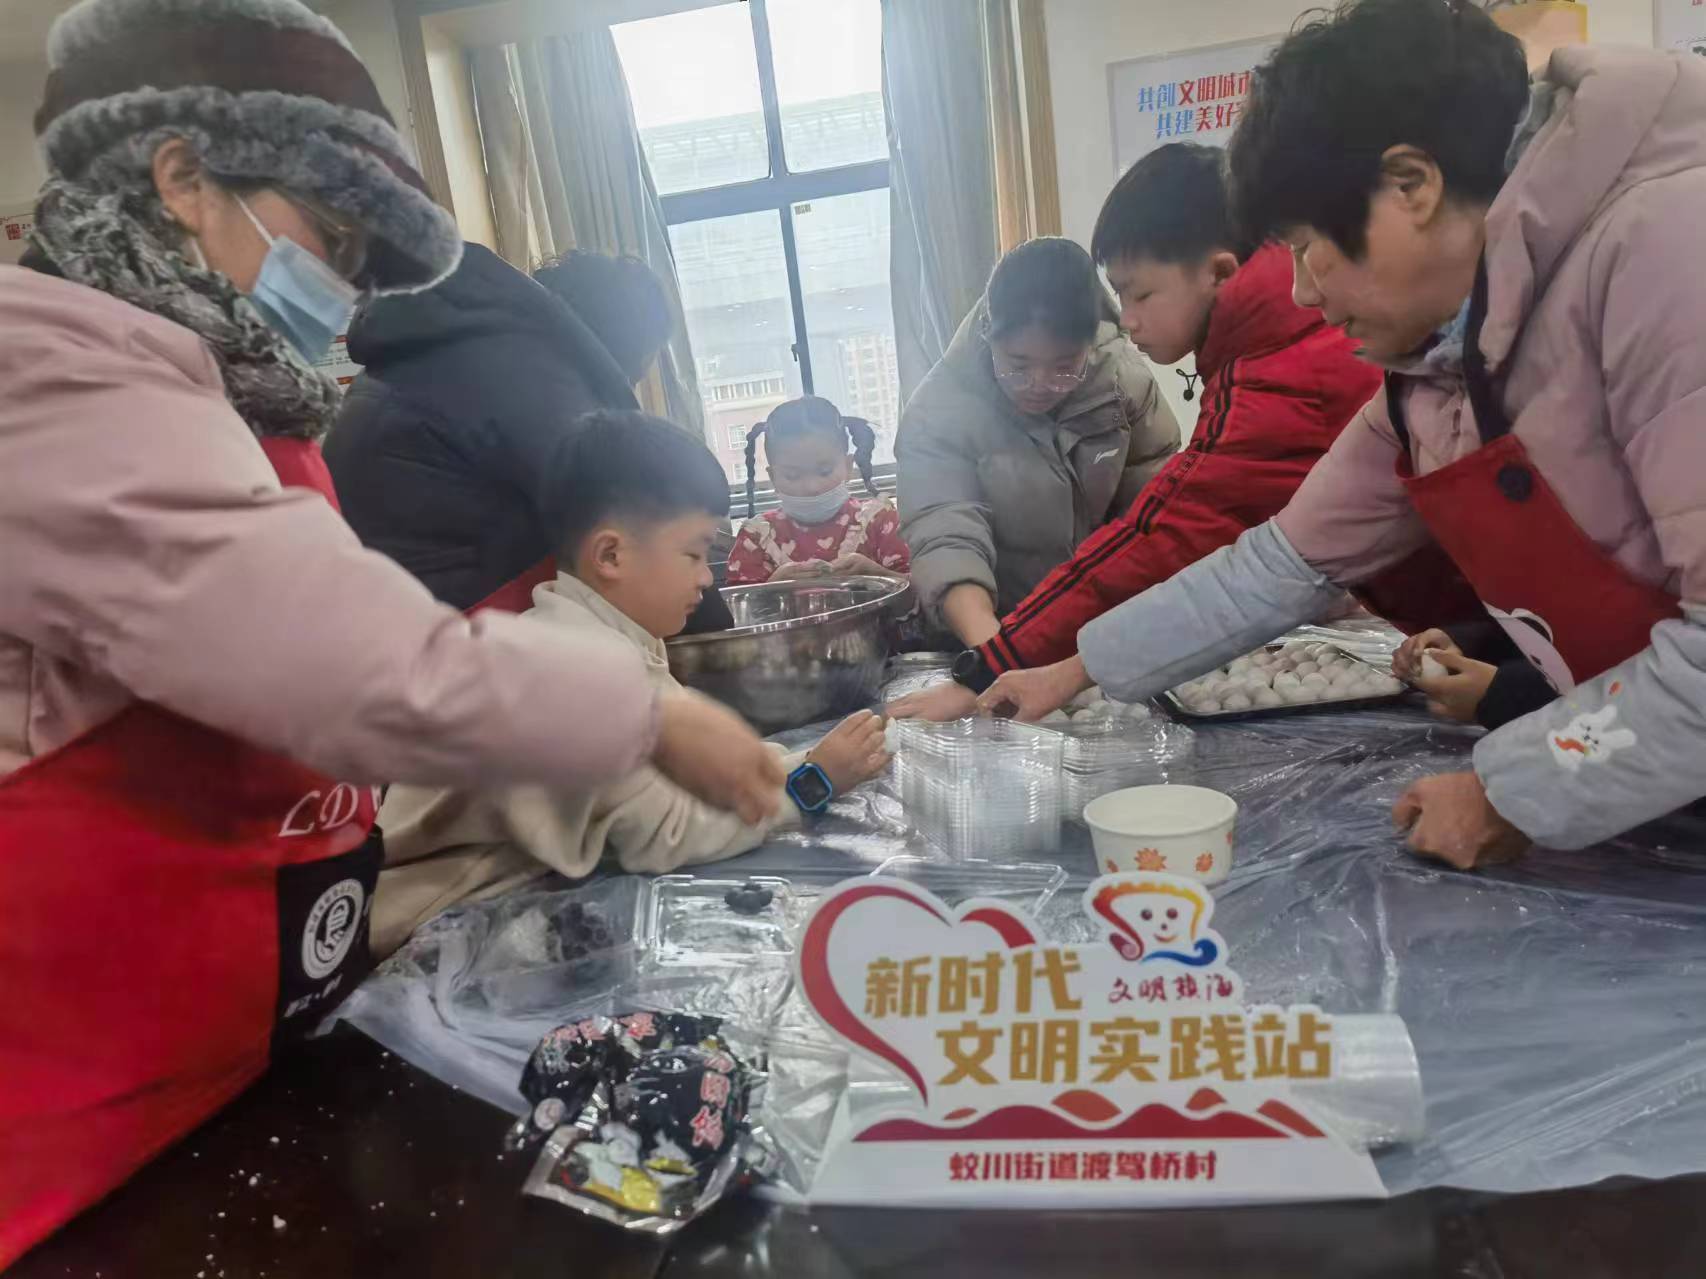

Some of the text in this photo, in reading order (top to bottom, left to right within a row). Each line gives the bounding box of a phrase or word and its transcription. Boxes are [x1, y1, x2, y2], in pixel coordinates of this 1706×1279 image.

[864, 949, 1083, 1019] 新时代
[935, 1013, 1332, 1086] 文明实践站
[948, 1150, 1217, 1183] 蛟川街道渡驾桥村
